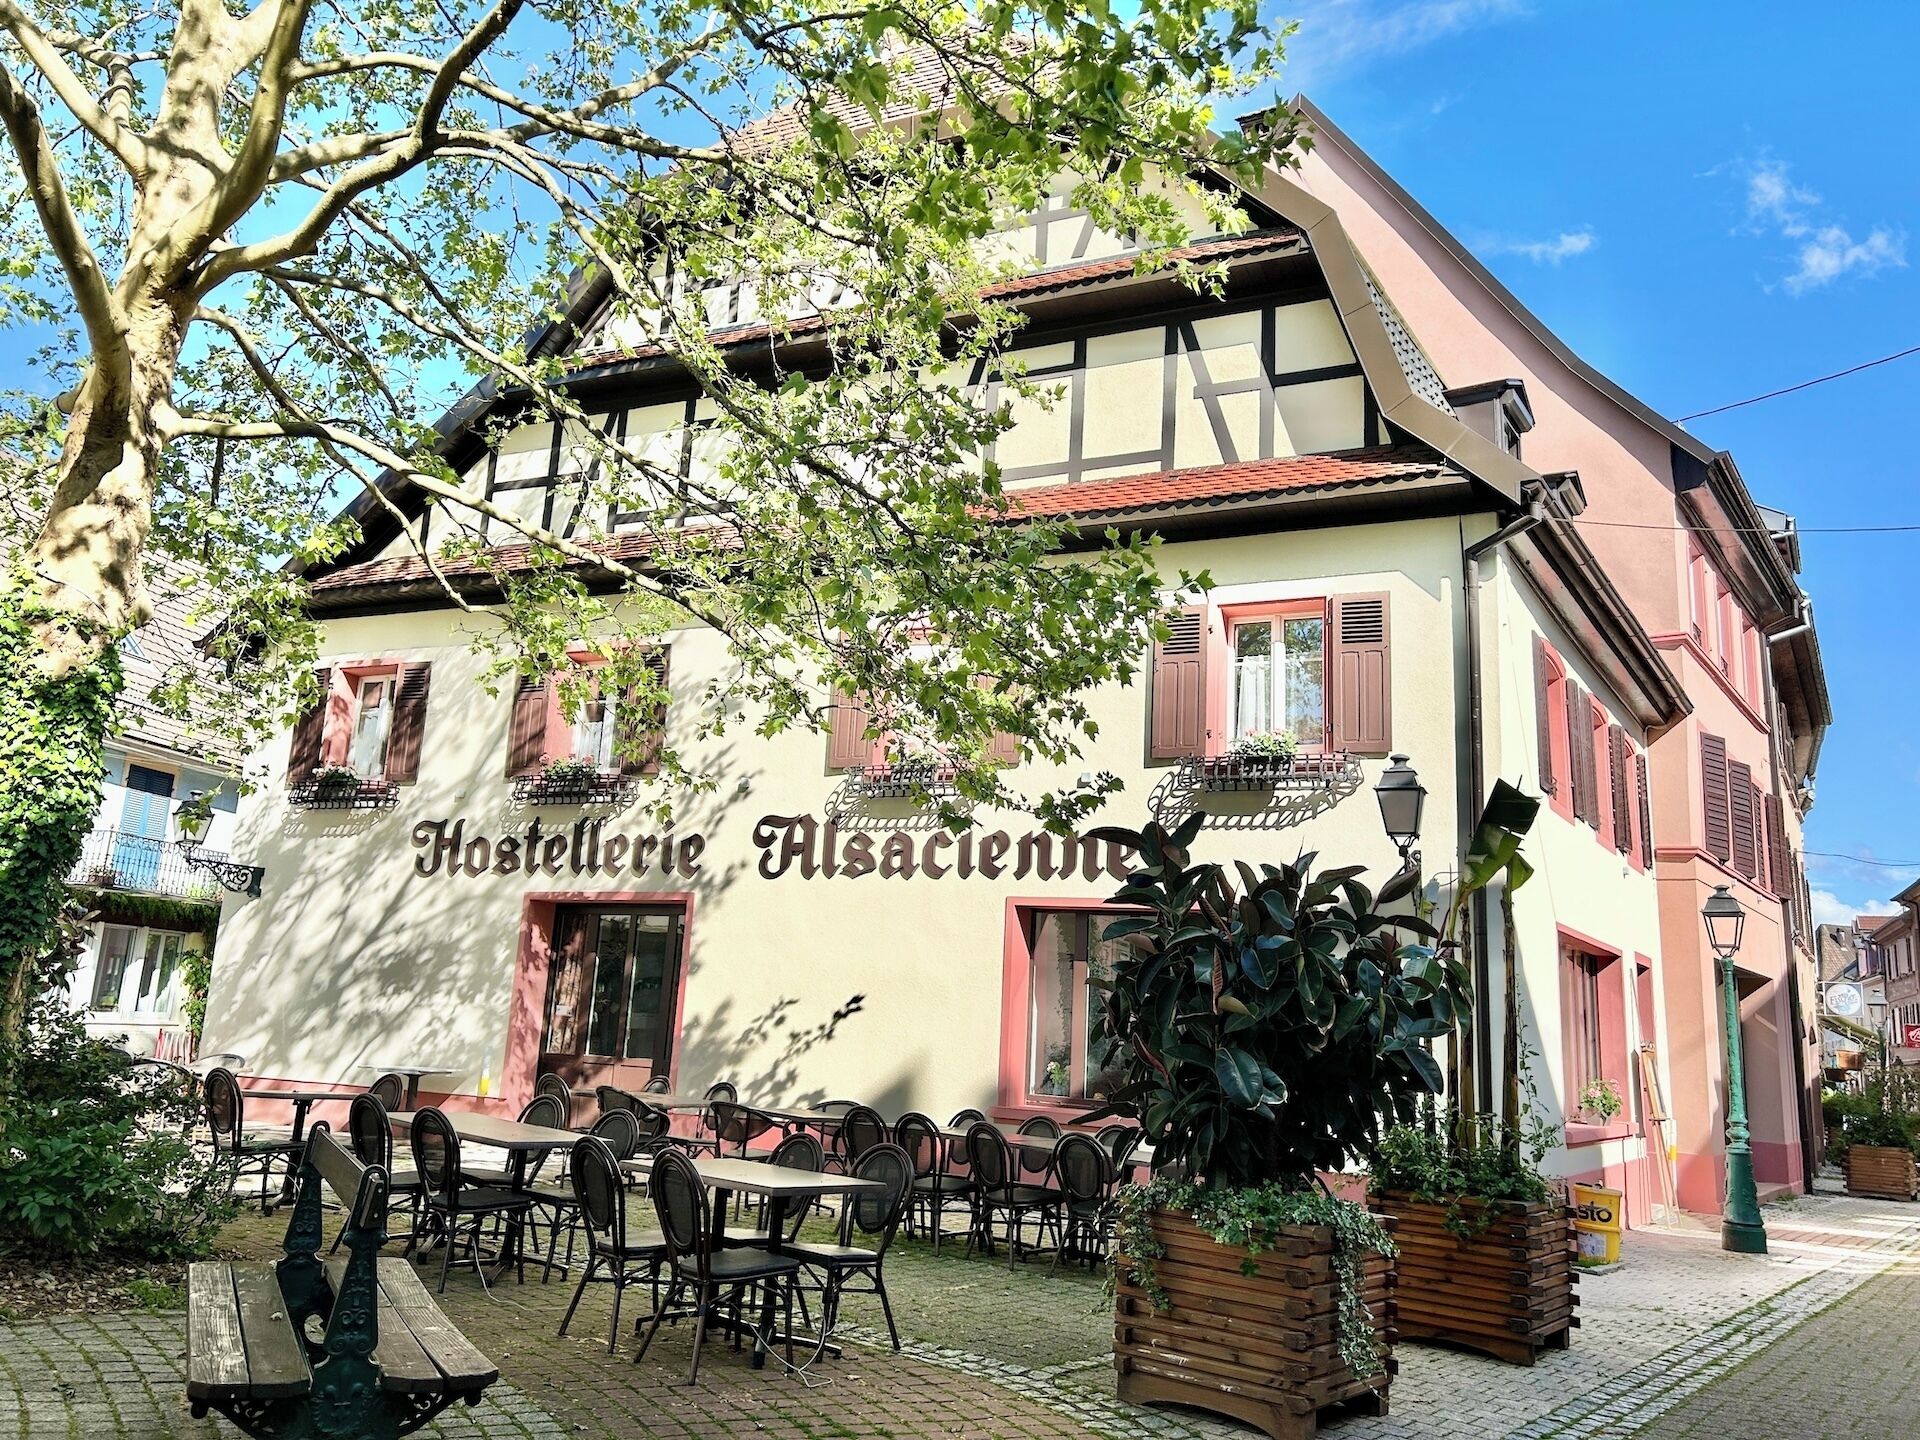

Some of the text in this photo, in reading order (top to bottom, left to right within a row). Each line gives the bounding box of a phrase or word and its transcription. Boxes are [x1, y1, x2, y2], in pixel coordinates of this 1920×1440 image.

[411, 813, 1138, 883] Hostellerie Alsacienne
[1578, 1201, 1612, 1223] sto
